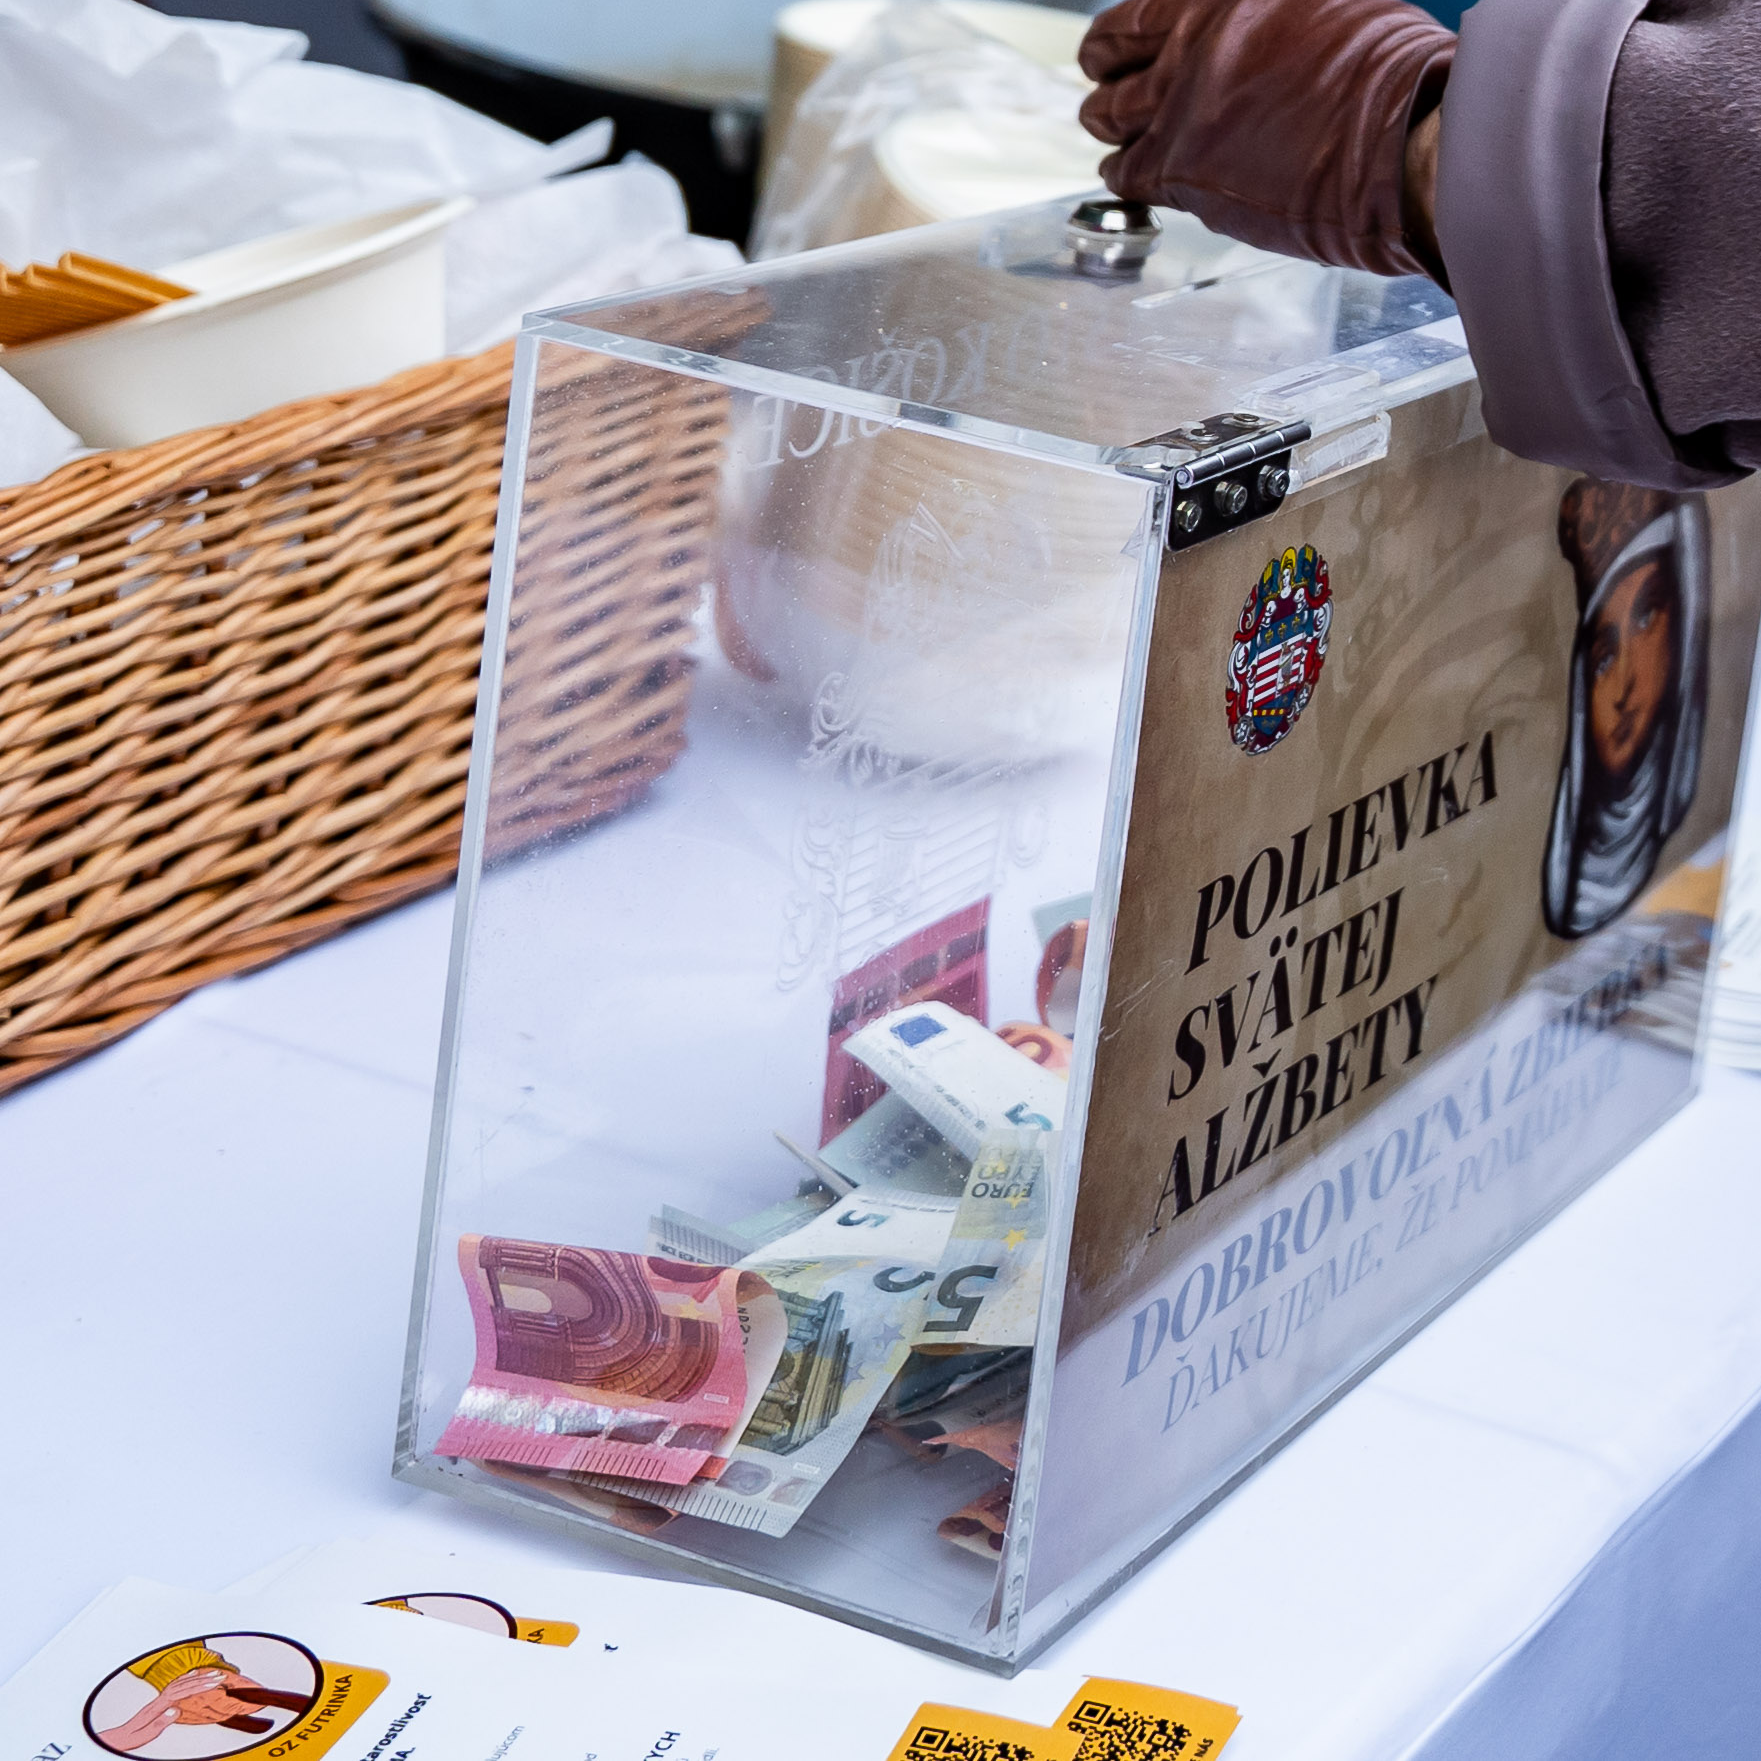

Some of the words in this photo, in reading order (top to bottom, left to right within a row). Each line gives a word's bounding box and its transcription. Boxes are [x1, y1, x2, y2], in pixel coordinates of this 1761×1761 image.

[1184, 730, 1498, 976] POLIEVKA
[1147, 973, 1439, 1238] ALŽBETY
[1167, 886, 1406, 1107] SVÄTEJ
[922, 1265, 999, 1333] 5
[971, 1182, 1034, 1199] EURO
[1121, 1041, 1498, 1388] DOBROVOĽNÁ
[1161, 1221, 1384, 1434] ĎAKUJEME,
[1395, 1175, 1447, 1253] ŽE
[268, 1739, 300, 1758] OZ
[296, 1674, 353, 1742] FUTRINKA
